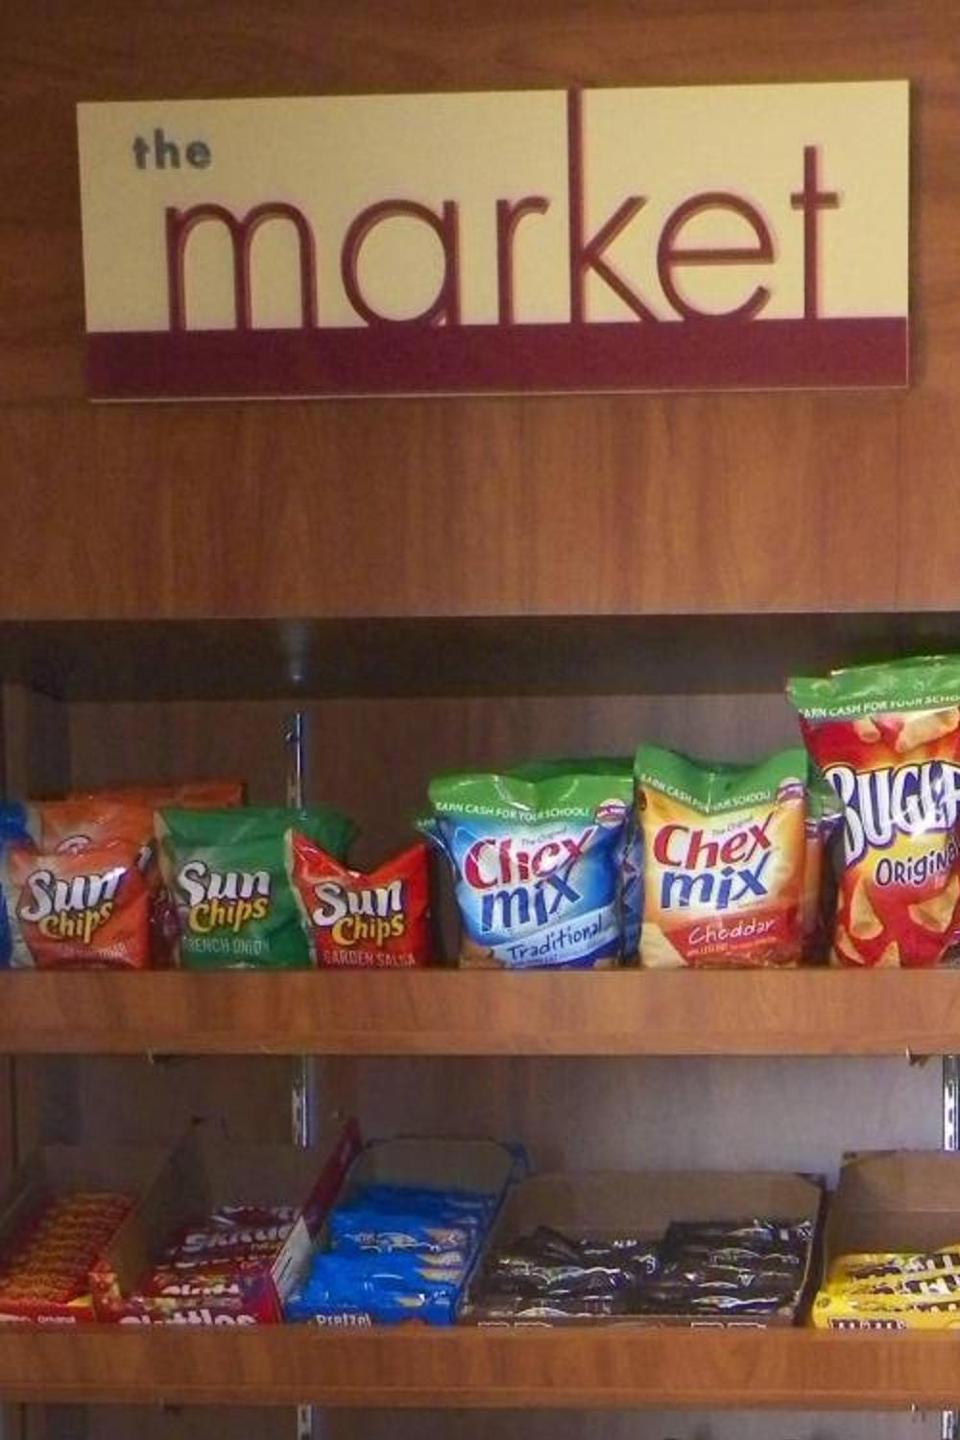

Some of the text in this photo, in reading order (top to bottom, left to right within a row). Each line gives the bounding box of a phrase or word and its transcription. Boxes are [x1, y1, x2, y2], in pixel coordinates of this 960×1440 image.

[132, 128, 213, 170] the
[165, 83, 842, 328] market
[464, 825, 601, 892] Chex
[653, 811, 776, 873] Chex
[17, 865, 128, 922] Sun
[177, 860, 271, 906] Sun
[312, 880, 403, 928] Sun
[481, 868, 586, 936] mix
[660, 853, 773, 911] mix
[188, 896, 269, 933] Chips
[330, 911, 405, 948] Chips
[688, 917, 776, 945] Cheddar
